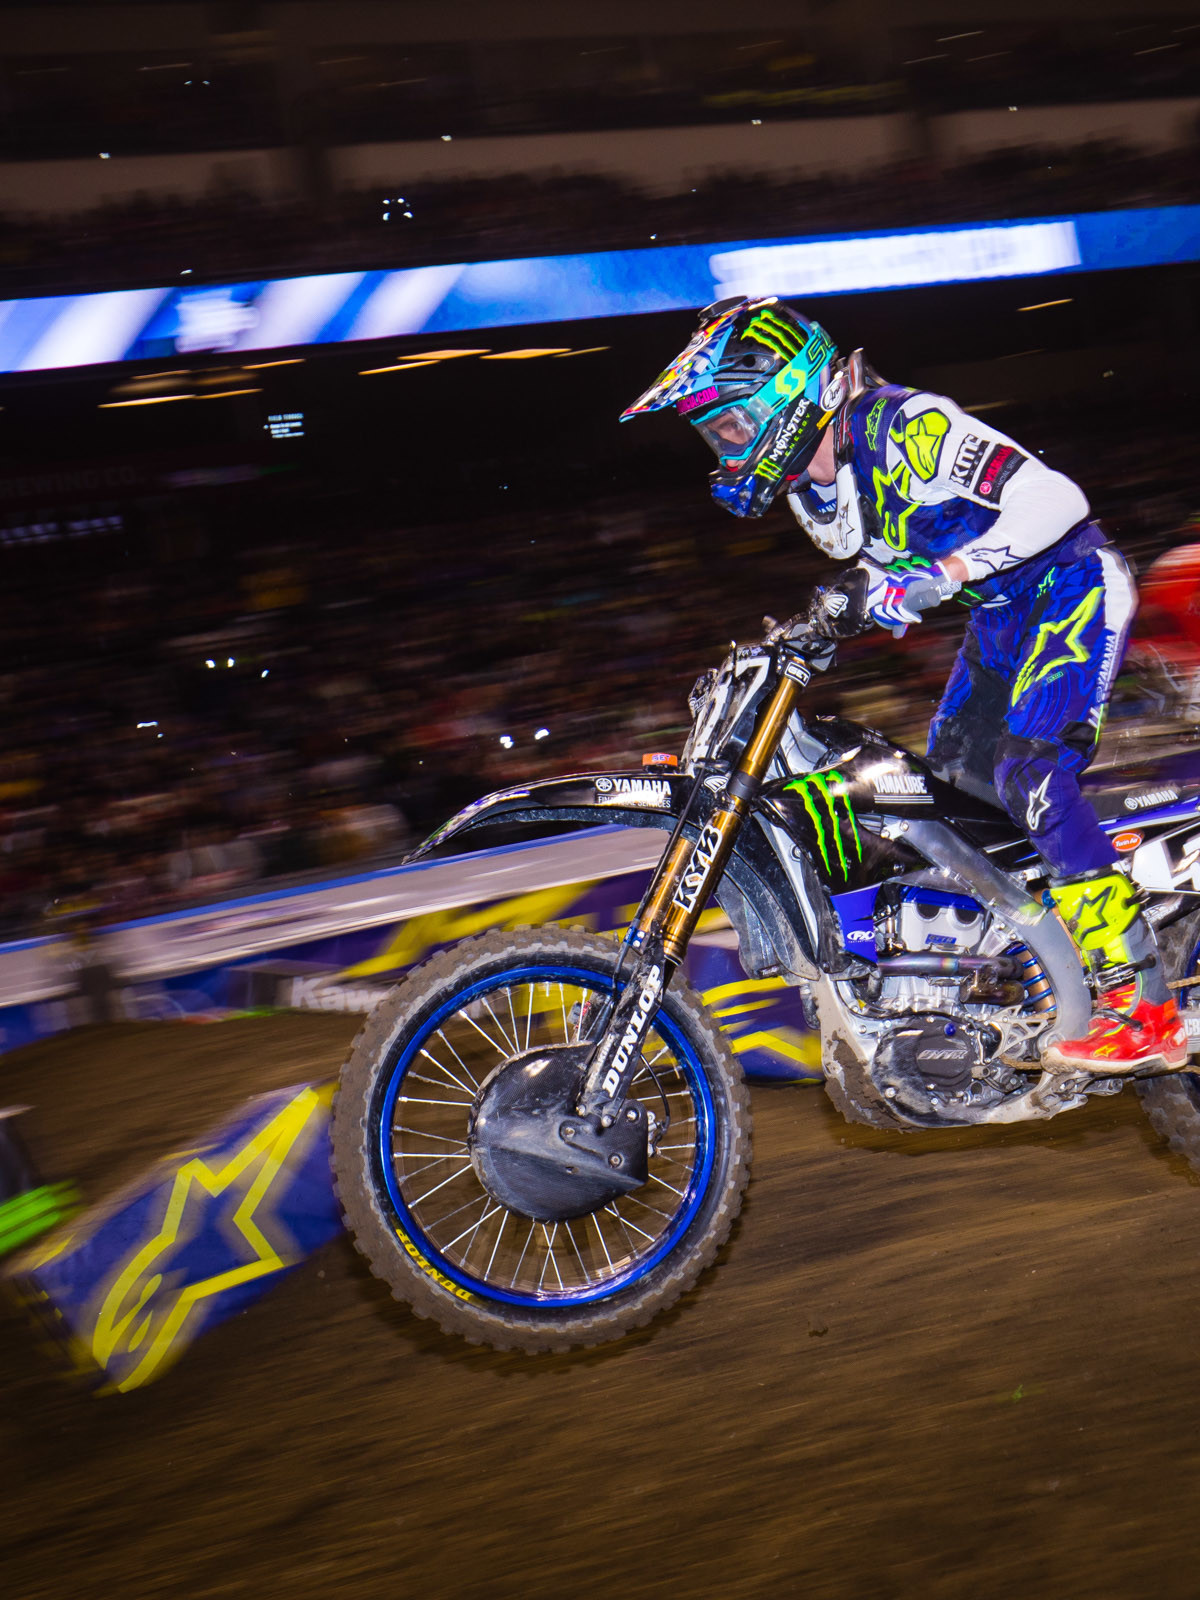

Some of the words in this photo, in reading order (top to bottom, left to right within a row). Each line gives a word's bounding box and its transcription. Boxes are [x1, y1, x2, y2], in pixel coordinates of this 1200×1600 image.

[769, 398, 810, 461] MONSTER
[950, 433, 980, 485] KMC
[787, 665, 810, 683] GET
[1097, 635, 1116, 686] YAMAHA
[613, 778, 672, 795] YAMAHA
[873, 775, 928, 794] YAMALUBE
[1135, 789, 1178, 808] YAMAHA
[602, 964, 661, 1098] DUNLOP
[396, 1229, 473, 1301] DUNLOP
